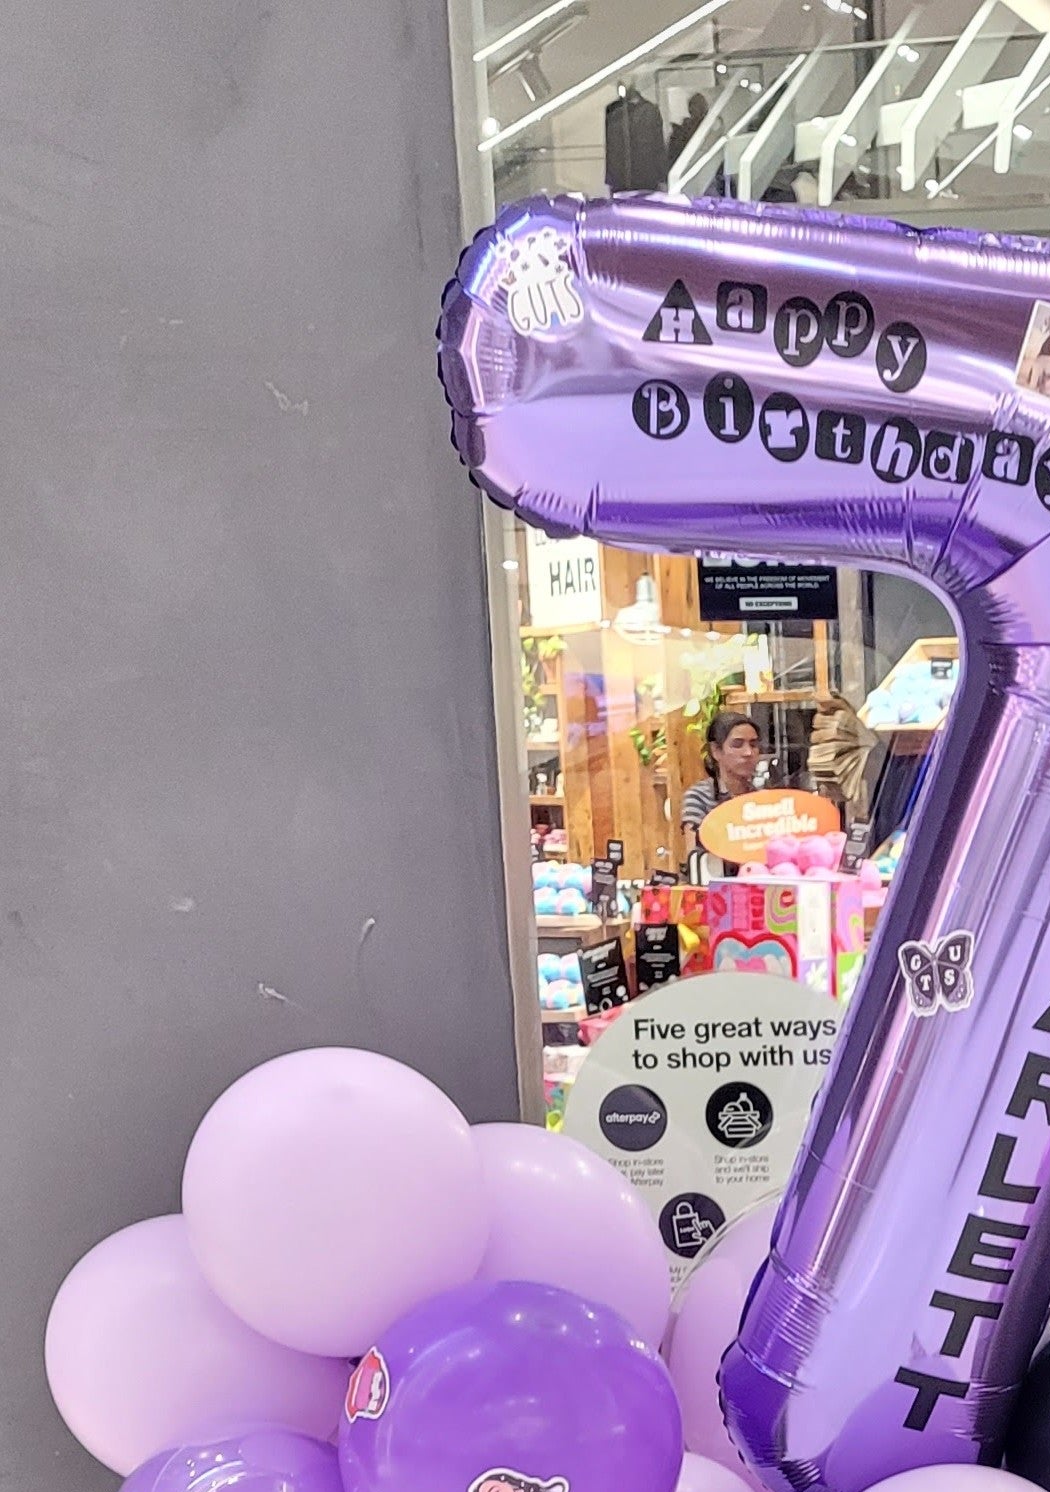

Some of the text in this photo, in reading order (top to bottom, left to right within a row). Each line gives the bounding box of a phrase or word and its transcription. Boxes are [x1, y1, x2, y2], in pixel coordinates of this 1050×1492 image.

[643, 281, 927, 393] Happy
[549, 558, 596, 597] HAIR
[633, 1018, 837, 1044] Five great ways
[632, 1044, 833, 1072] to shop with us
[606, 1112, 648, 1125] afterpay
